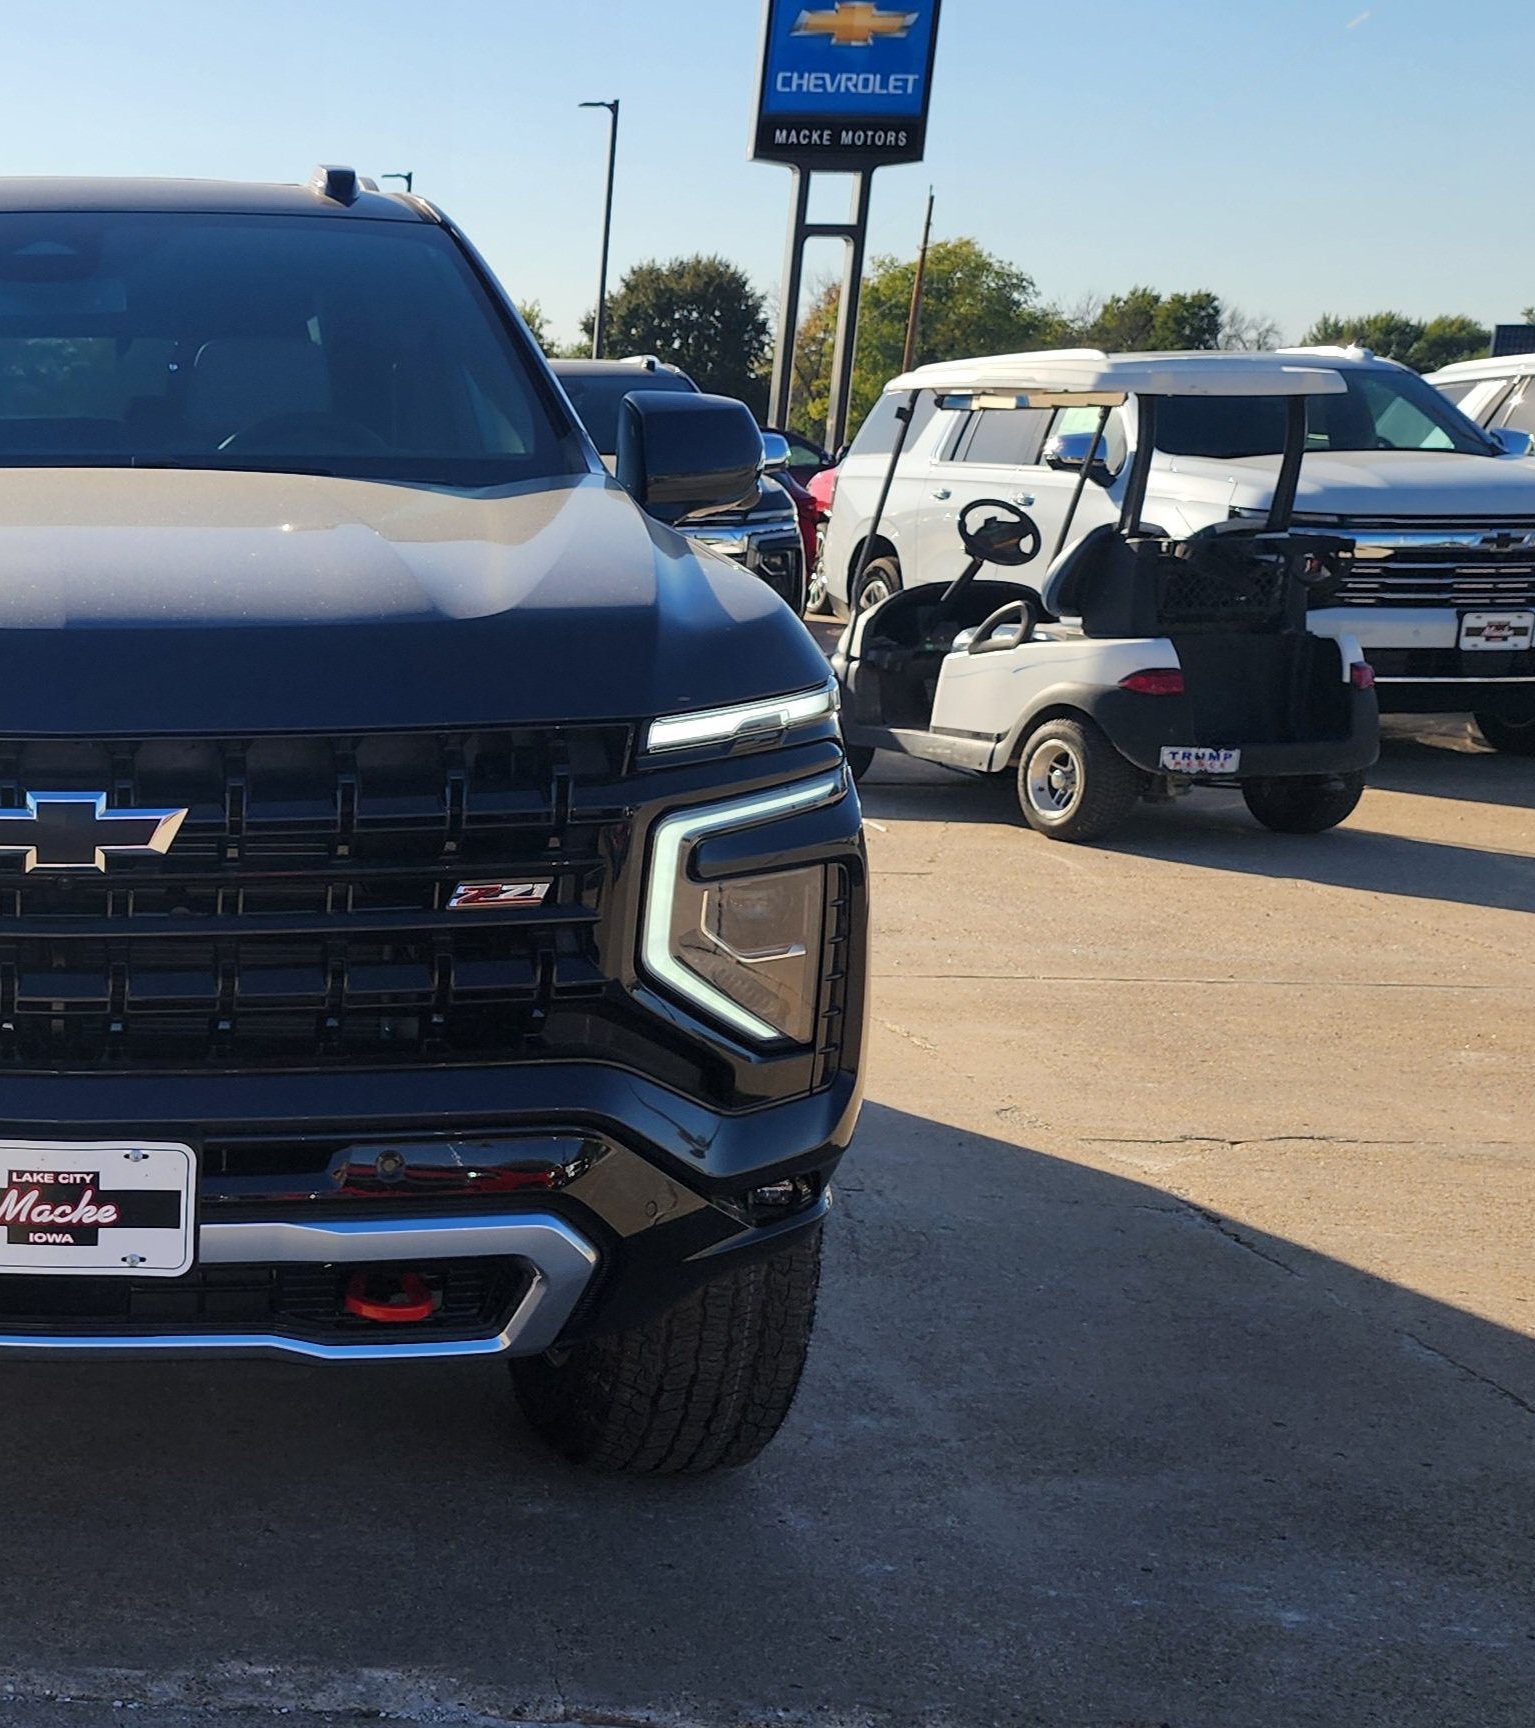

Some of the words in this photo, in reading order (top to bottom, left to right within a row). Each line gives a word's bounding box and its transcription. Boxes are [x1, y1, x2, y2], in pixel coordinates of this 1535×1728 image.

[775, 71, 919, 94] CHEVROLET
[774, 128, 832, 146] MACKE
[840, 129, 908, 147] MOTORS
[1168, 751, 1233, 761] TRUMP
[449, 883, 551, 907] Z71
[11, 1171, 55, 1184] LAKE
[57, 1172, 95, 1185] CITY
[28, 1232, 75, 1244] IOWA
